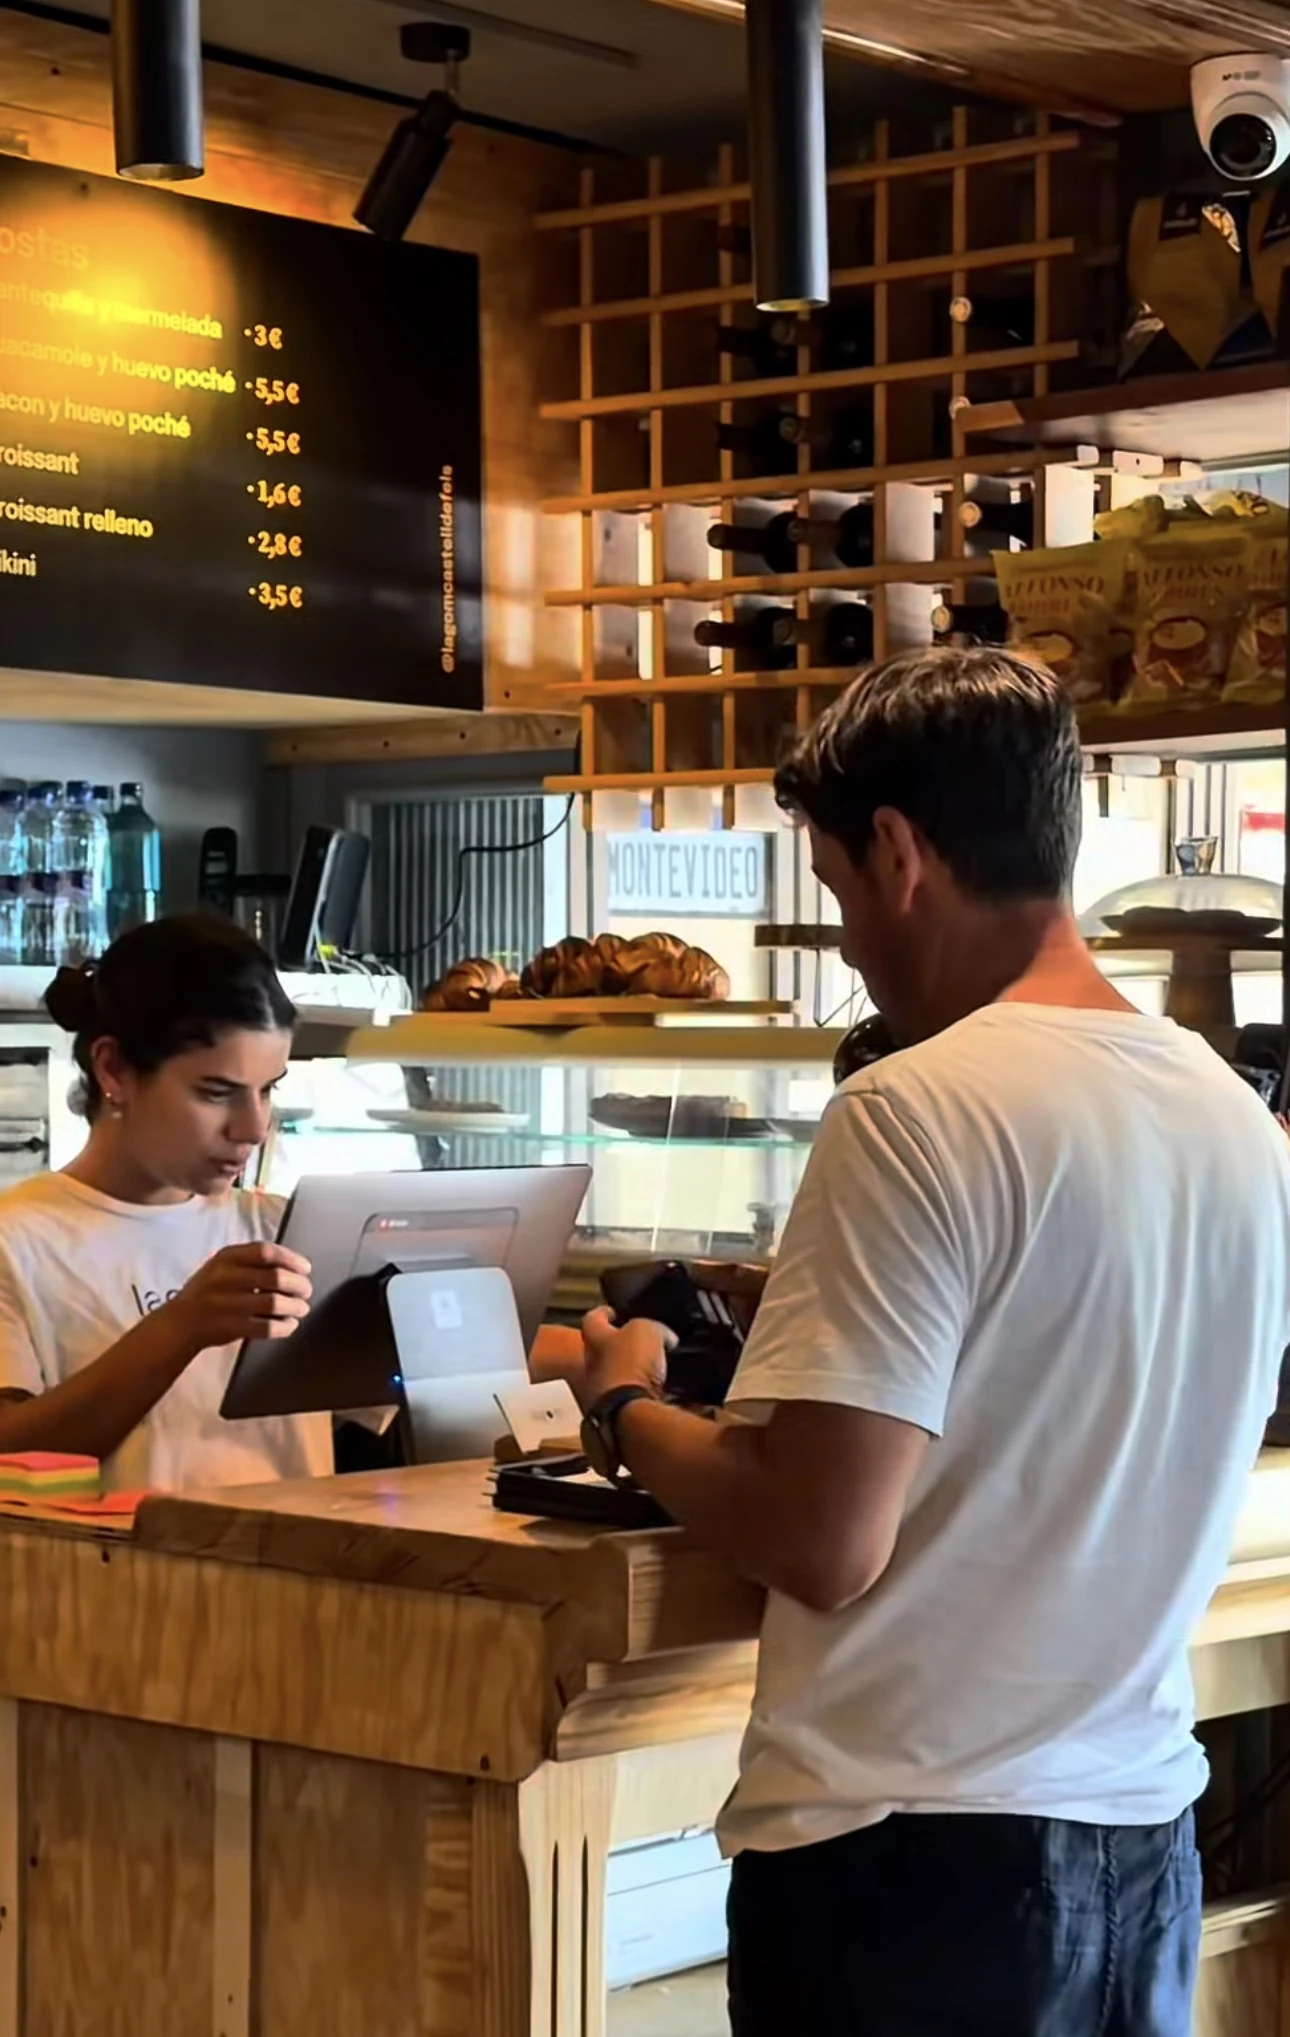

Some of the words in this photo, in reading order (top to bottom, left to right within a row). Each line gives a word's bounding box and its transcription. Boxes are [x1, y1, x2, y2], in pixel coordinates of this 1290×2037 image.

[96, 354, 108, 377] y
[112, 350, 171, 382] huevo
[174, 366, 236, 394] poché
[47, 397, 61, 424] y
[64, 395, 126, 428] huevo
[128, 411, 192, 438] poché
[83, 508, 154, 538] relleno
[607, 842, 759, 900] MONTEVIDEO
